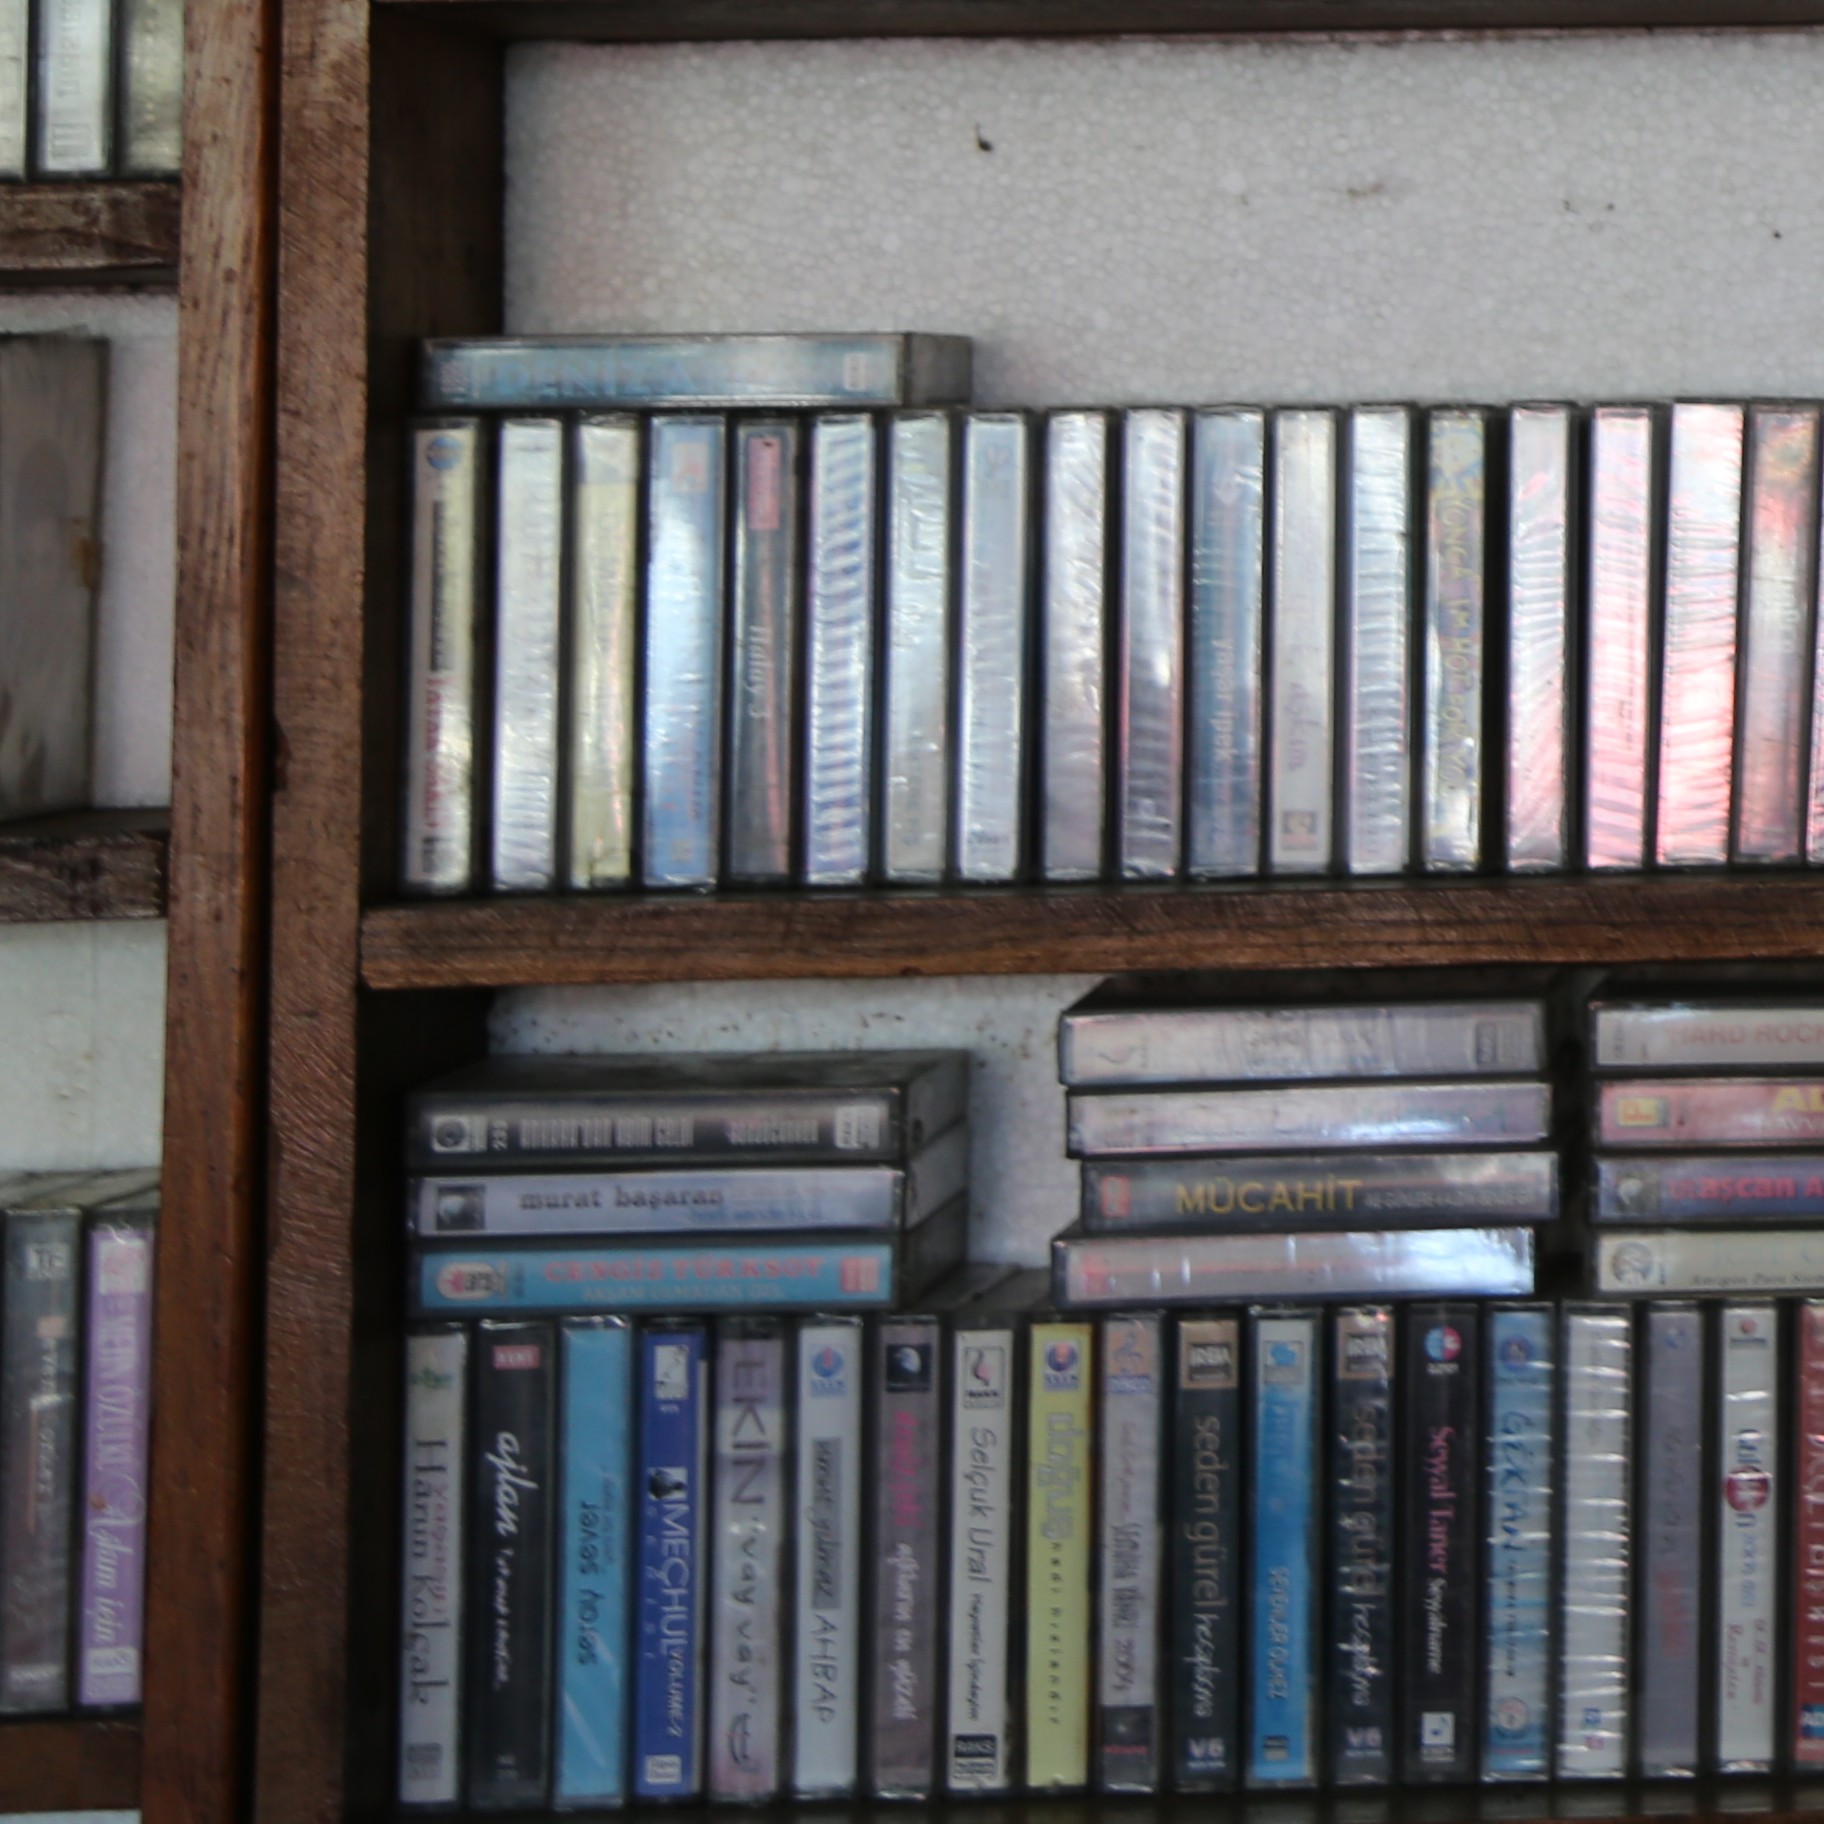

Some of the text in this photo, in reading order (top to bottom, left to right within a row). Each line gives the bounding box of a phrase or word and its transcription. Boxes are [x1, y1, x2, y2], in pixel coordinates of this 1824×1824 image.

[1666, 1024, 1747, 1045] HARD
[520, 1187, 725, 1211] murat başaran
[1176, 1175, 1363, 1215] MÜCAHİT
[485, 1430, 538, 1536] ajlan
[966, 1427, 995, 1582] Selçuk Ural
[1036, 1410, 1088, 1540] doğuş
[1186, 1416, 1227, 1606] seden gürel
[1352, 1405, 1385, 1505] seden
[1424, 1426, 1457, 1574] Seyyal Taner
[405, 1440, 451, 1705] Harun Kolçak
[655, 1503, 689, 1653] MEÇHUL
[810, 1615, 838, 1723] AHBAP
